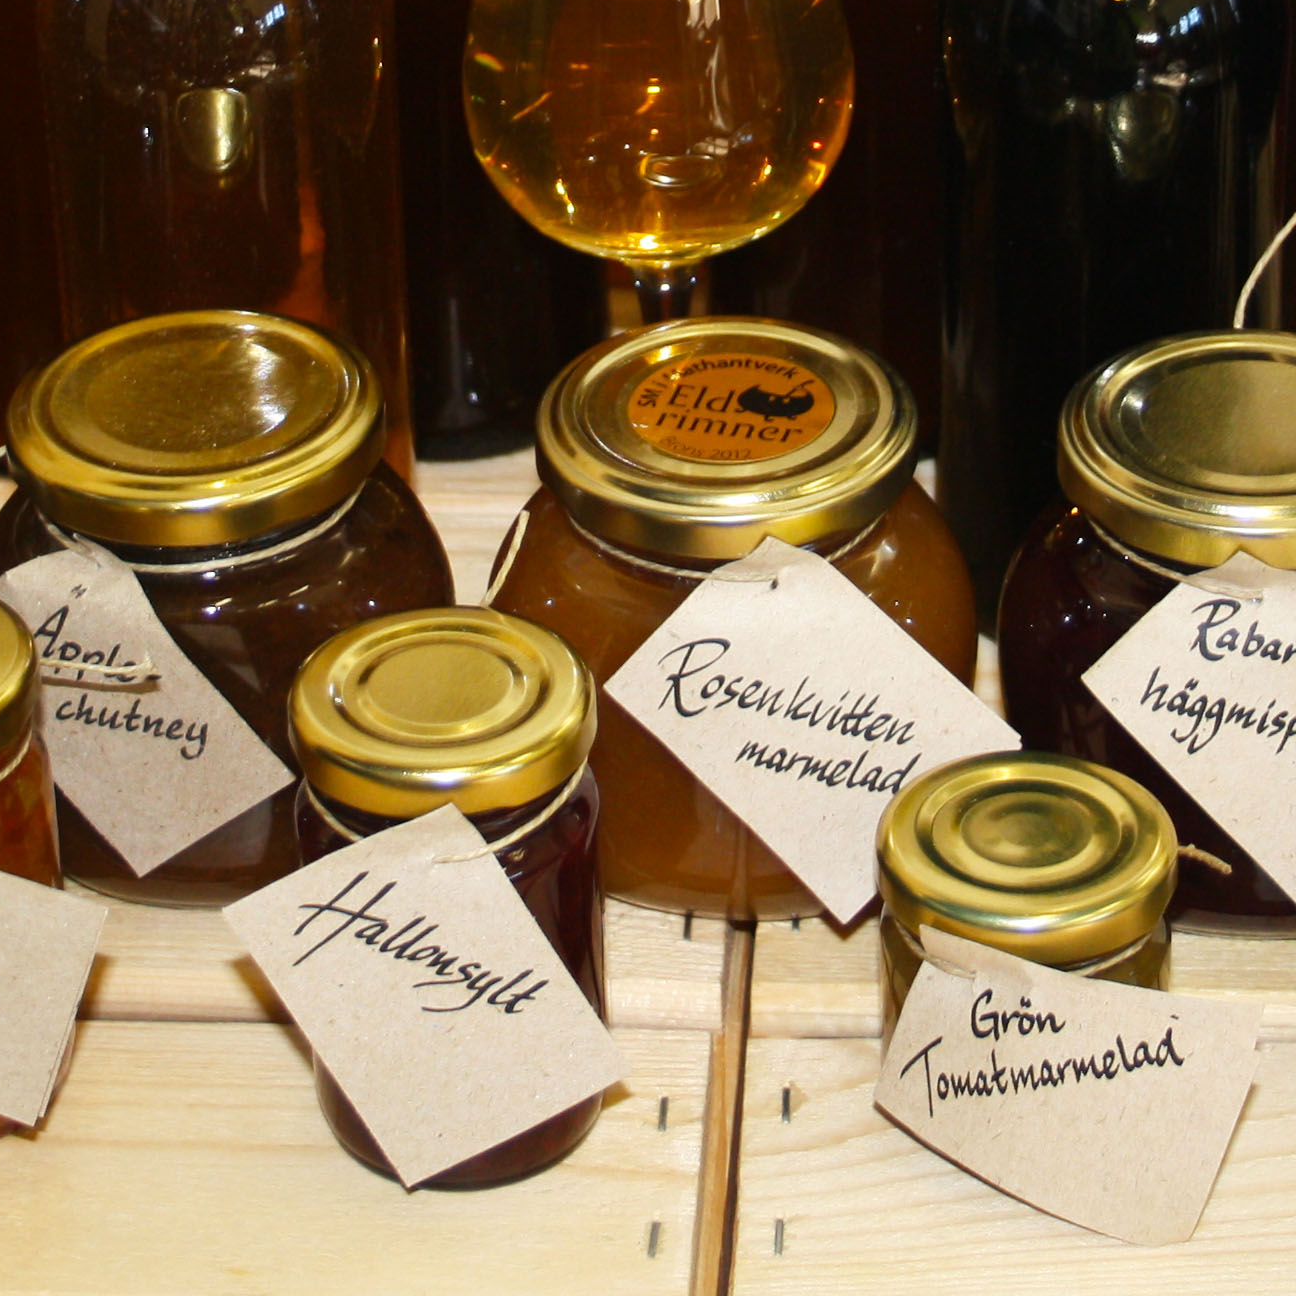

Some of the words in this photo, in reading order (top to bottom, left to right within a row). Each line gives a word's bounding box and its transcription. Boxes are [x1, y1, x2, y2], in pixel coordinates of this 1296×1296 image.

[656, 408, 803, 443] rimner
[659, 638, 915, 745] Rosenkvitten
[56, 693, 207, 760] chutney
[735, 740, 922, 794] marmelad
[294, 871, 550, 1016] Hallonsylt
[970, 988, 1066, 1038] Grön
[899, 1013, 1186, 1118] Tomatmarmelad
